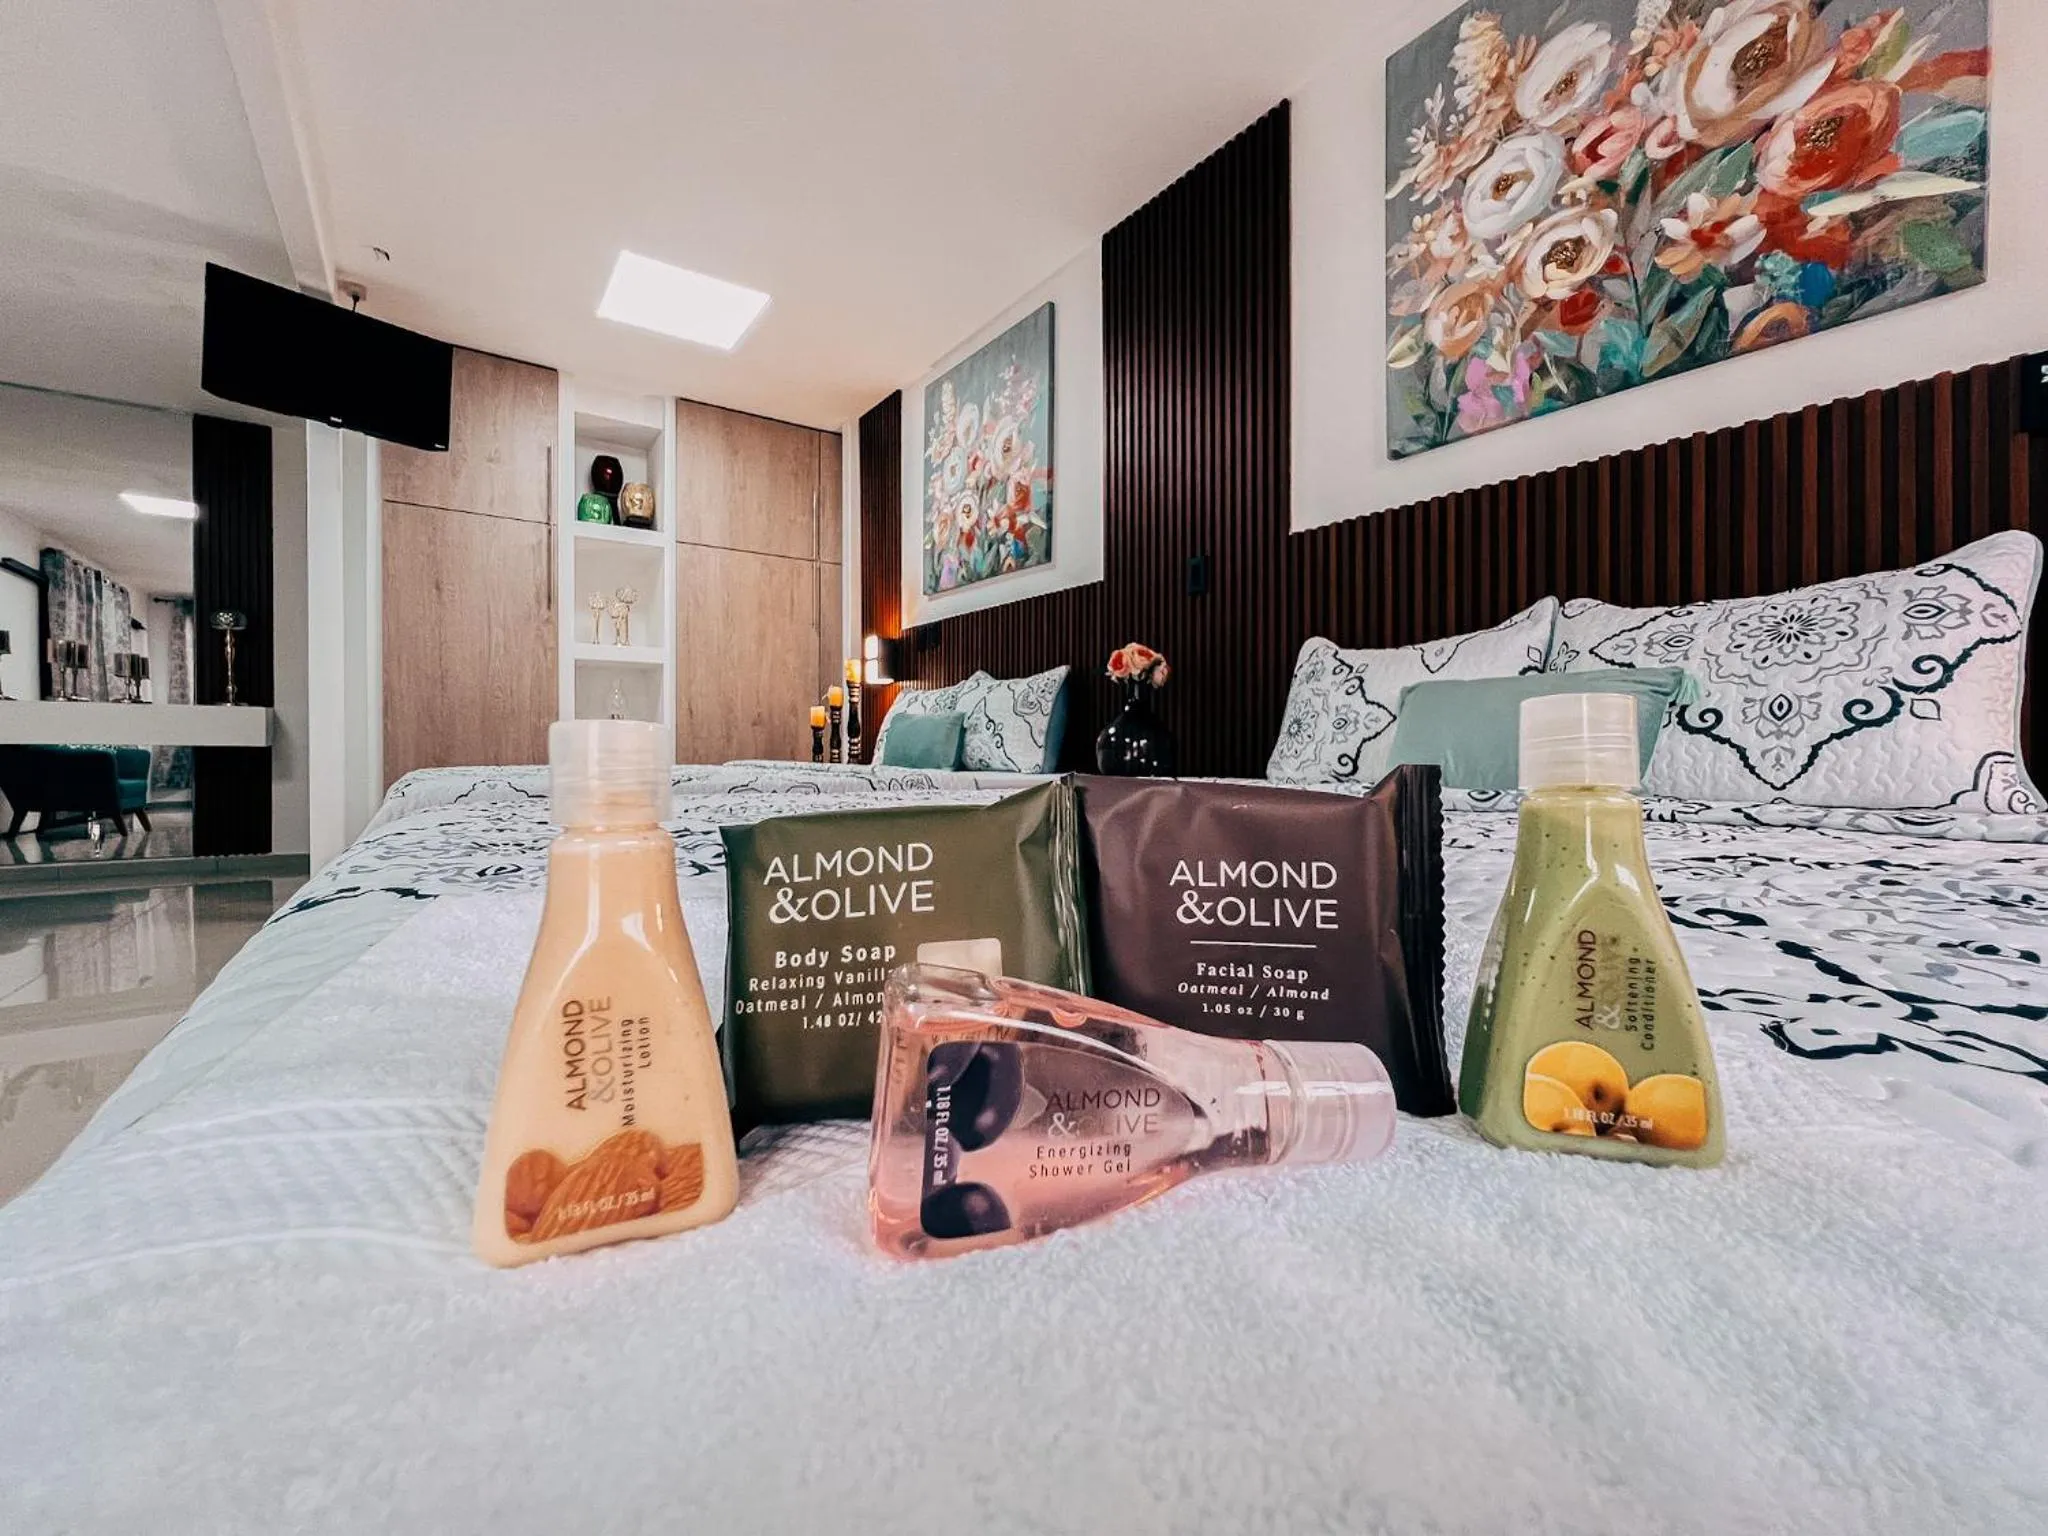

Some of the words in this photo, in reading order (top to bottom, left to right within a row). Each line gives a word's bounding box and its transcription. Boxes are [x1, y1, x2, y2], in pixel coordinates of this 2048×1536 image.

[763, 843, 934, 885] ALMOND
[1169, 860, 1338, 889] ALMOND
[768, 880, 935, 925] &OLIVE
[1176, 890, 1339, 929] &OLIVE
[775, 948, 829, 968] Body
[841, 945, 896, 963] Soap
[749, 973, 825, 992] Relaxing
[834, 967, 894, 985] Vanill
[1196, 962, 1253, 978] Facial
[1262, 964, 1309, 983] Soap
[1574, 930, 1596, 1031] ALMOND
[735, 995, 806, 1015] Oatmeal
[833, 991, 885, 1007] Almon
[1177, 982, 1244, 996] Oatmeal
[1266, 986, 1330, 1001] Almond
[1202, 1002, 1231, 1015] 1.05
[1237, 1005, 1253, 1016] oz
[1273, 1006, 1290, 1018] 30
[1296, 1008, 1305, 1021] g
[1641, 958, 1657, 1051] Conditioner
[803, 1014, 831, 1030] 1.48
[638, 1016, 652, 1069] Lotion
[562, 1000, 586, 1111] ALMOND
[619, 1018, 636, 1127] Moisturizing
[1045, 1087, 1160, 1112] ALMOND
[1037, 1141, 1132, 1159] Energizing
[1029, 1163, 1093, 1179] Shower
[1104, 1158, 1130, 1173] Gel
